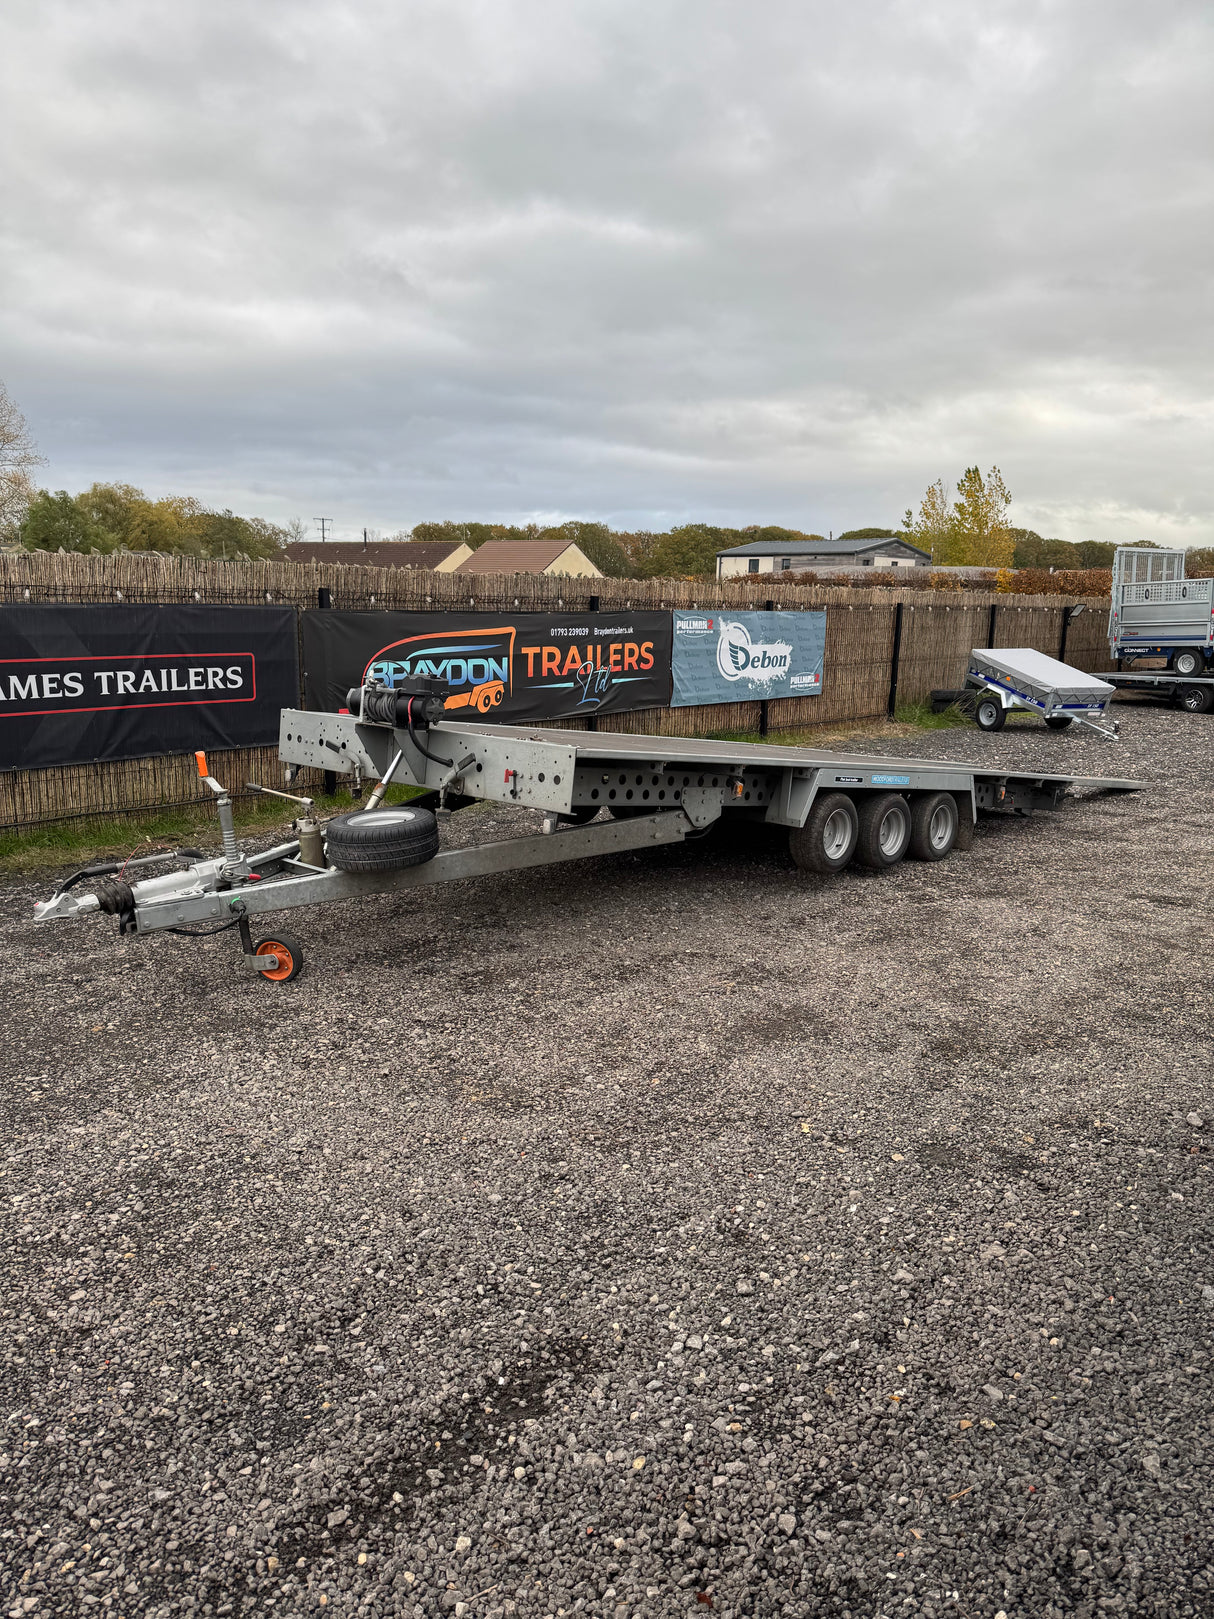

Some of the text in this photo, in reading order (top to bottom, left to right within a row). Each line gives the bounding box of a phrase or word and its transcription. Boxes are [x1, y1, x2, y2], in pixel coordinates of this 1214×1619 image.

[550, 627, 589, 637] 01793 239039
[521, 641, 655, 678] TRAILERS
[728, 639, 787, 672] Debon
[0, 666, 244, 701] MES TRAILERS
[576, 660, 612, 706] Ltd
